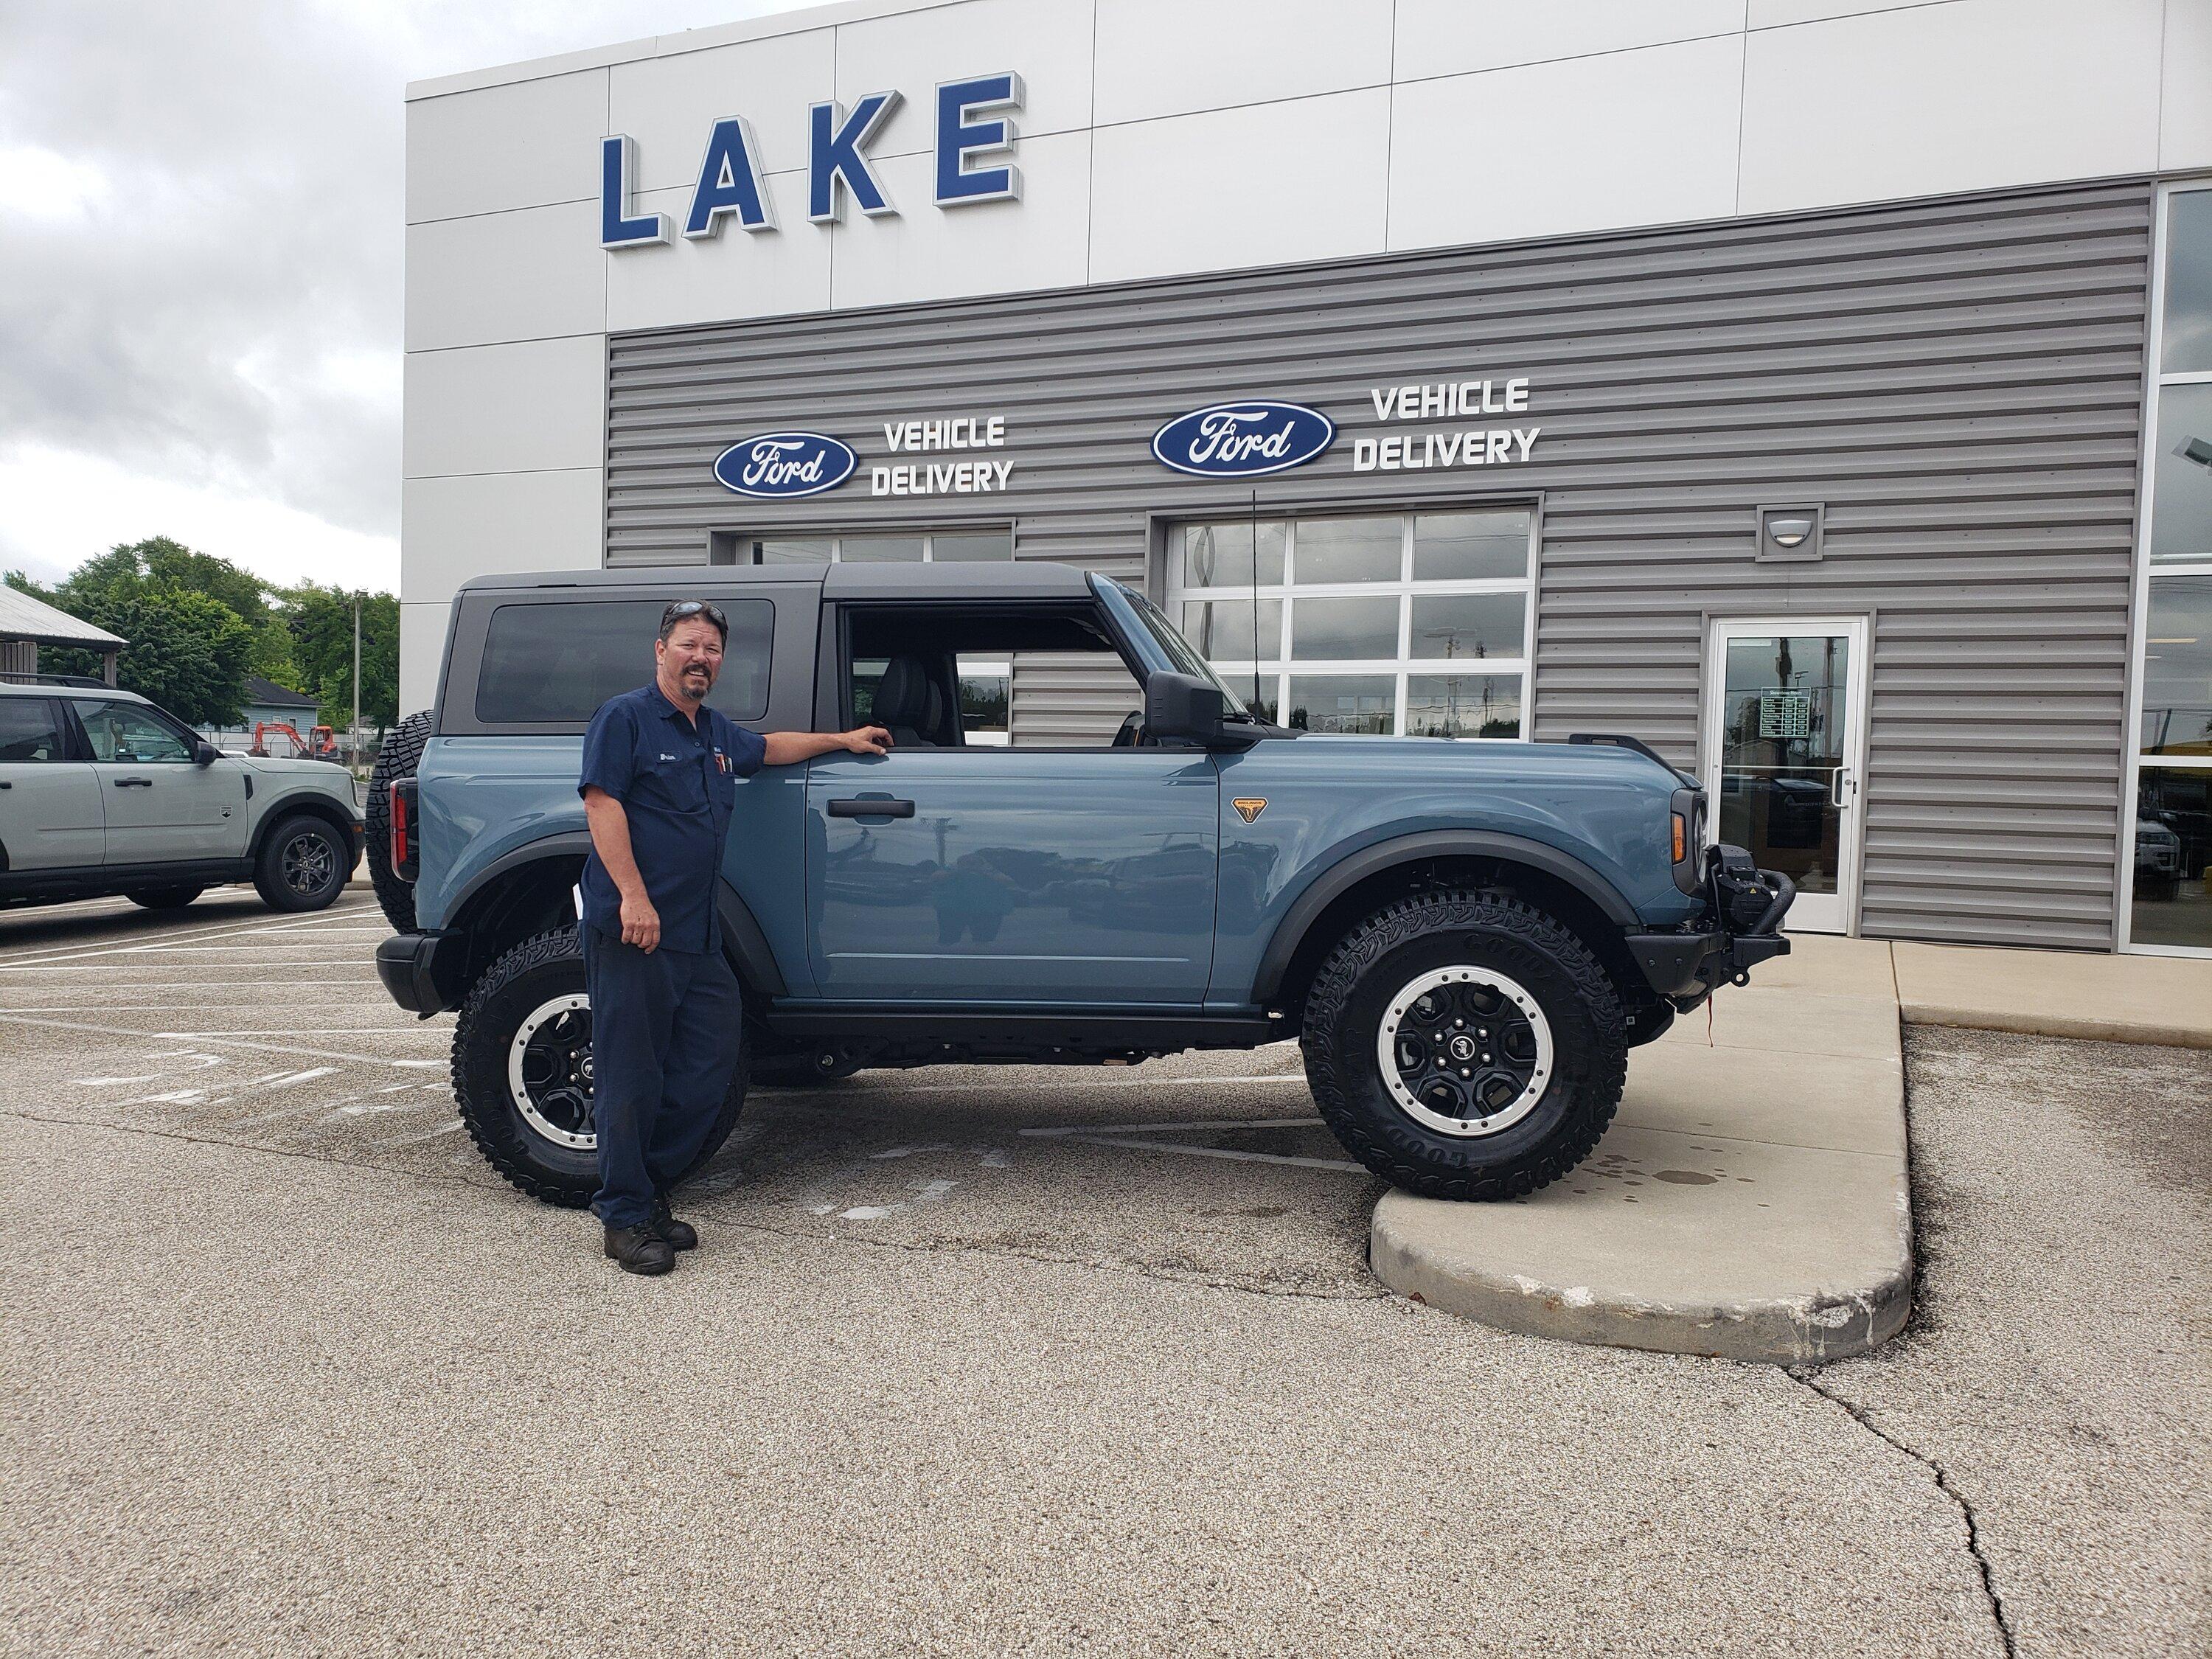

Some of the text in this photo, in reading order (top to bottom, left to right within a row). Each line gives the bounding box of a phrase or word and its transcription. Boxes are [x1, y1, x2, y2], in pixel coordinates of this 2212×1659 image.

[599, 70, 1024, 251] LAKE
[1371, 378, 1530, 422] VEHICLE
[883, 416, 1006, 453] VEHICLE
[1188, 411, 1295, 463] Ford
[1352, 428, 1543, 472] DELIVERY
[742, 440, 824, 487] Ford
[872, 460, 1015, 497] DELIVERY
